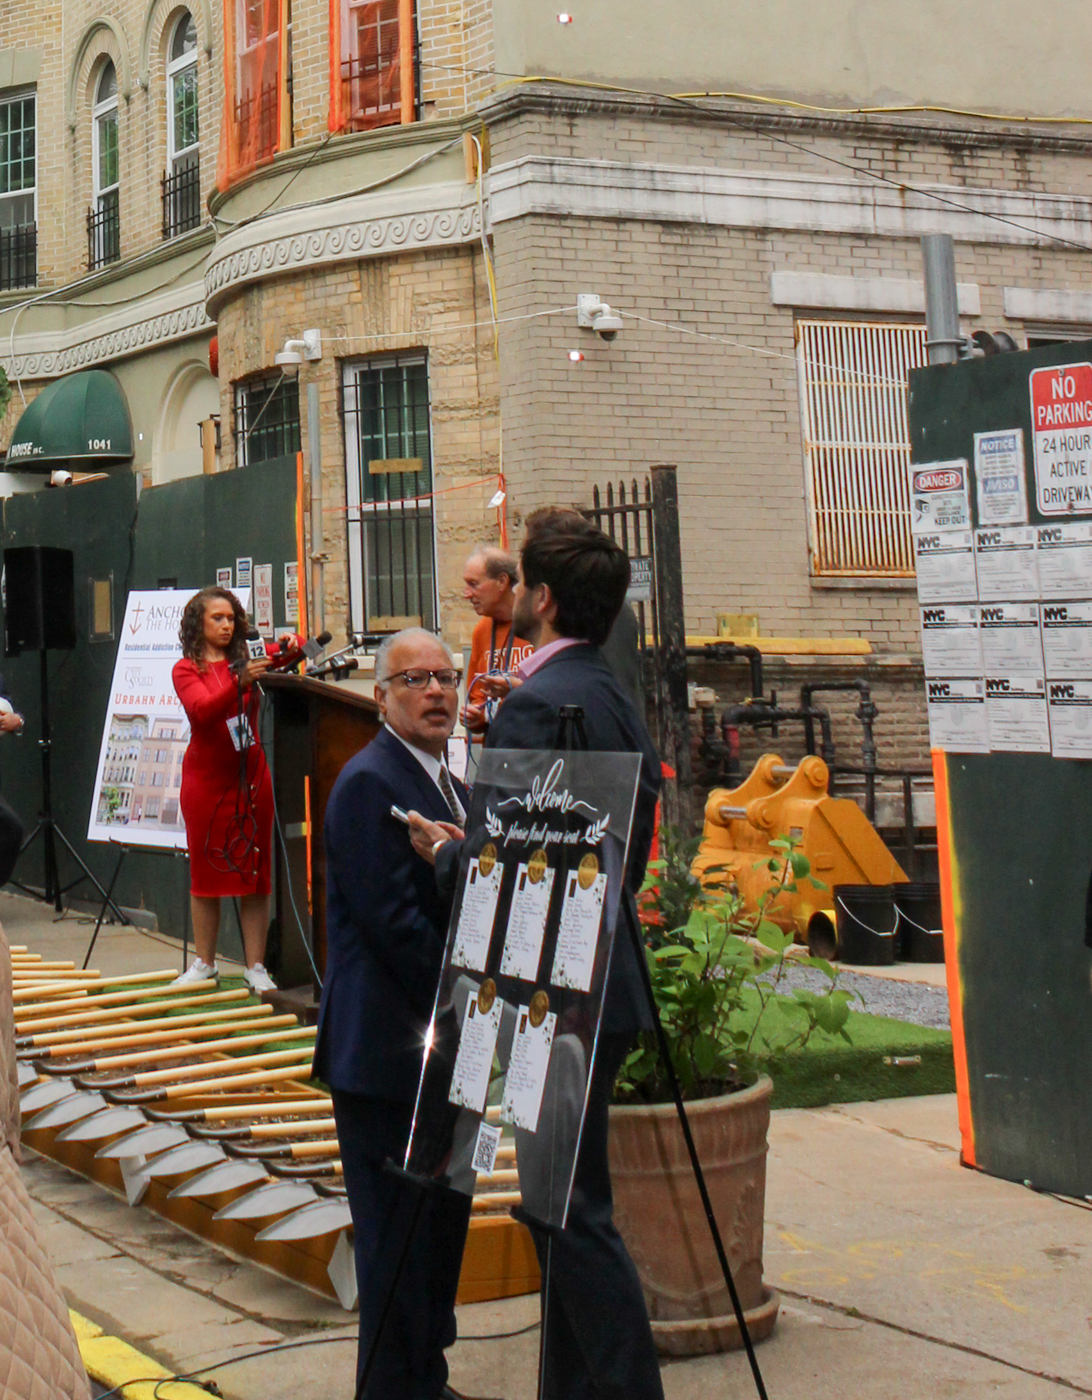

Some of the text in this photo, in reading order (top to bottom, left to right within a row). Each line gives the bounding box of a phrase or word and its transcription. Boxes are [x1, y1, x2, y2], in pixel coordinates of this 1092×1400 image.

[1051, 375, 1076, 400] NO
[1037, 400, 1092, 426] PARKING
[11, 442, 33, 457] HOUSE
[88, 439, 111, 450] 1041
[980, 439, 1015, 454] NOTICE
[1042, 434, 1091, 454] 24 HOUR
[1050, 459, 1087, 478] ACTIVE
[919, 474, 956, 488] DANGER
[985, 478, 1016, 492] AVISO
[1043, 482, 1092, 504] DRIVEWA
[934, 515, 965, 526] KEEP OUT
[977, 532, 1002, 545] NYC
[1038, 528, 1062, 542] NYC
[918, 536, 940, 549] NYC
[147, 605, 185, 618] ANCHO
[923, 610, 946, 622] NYC
[980, 608, 1004, 621] NYC
[1044, 607, 1068, 620] NYC
[146, 618, 180, 631] THE HO
[251, 646, 265, 657] 12
[928, 683, 951, 697] NYC
[986, 679, 1010, 692] NYC
[1050, 685, 1074, 698] NYC
[115, 693, 183, 707] URBAHN ARC
[497, 757, 598, 814] welcome
[503, 821, 529, 849] please
[523, 821, 548, 849] find
[563, 829, 581, 845] seat
